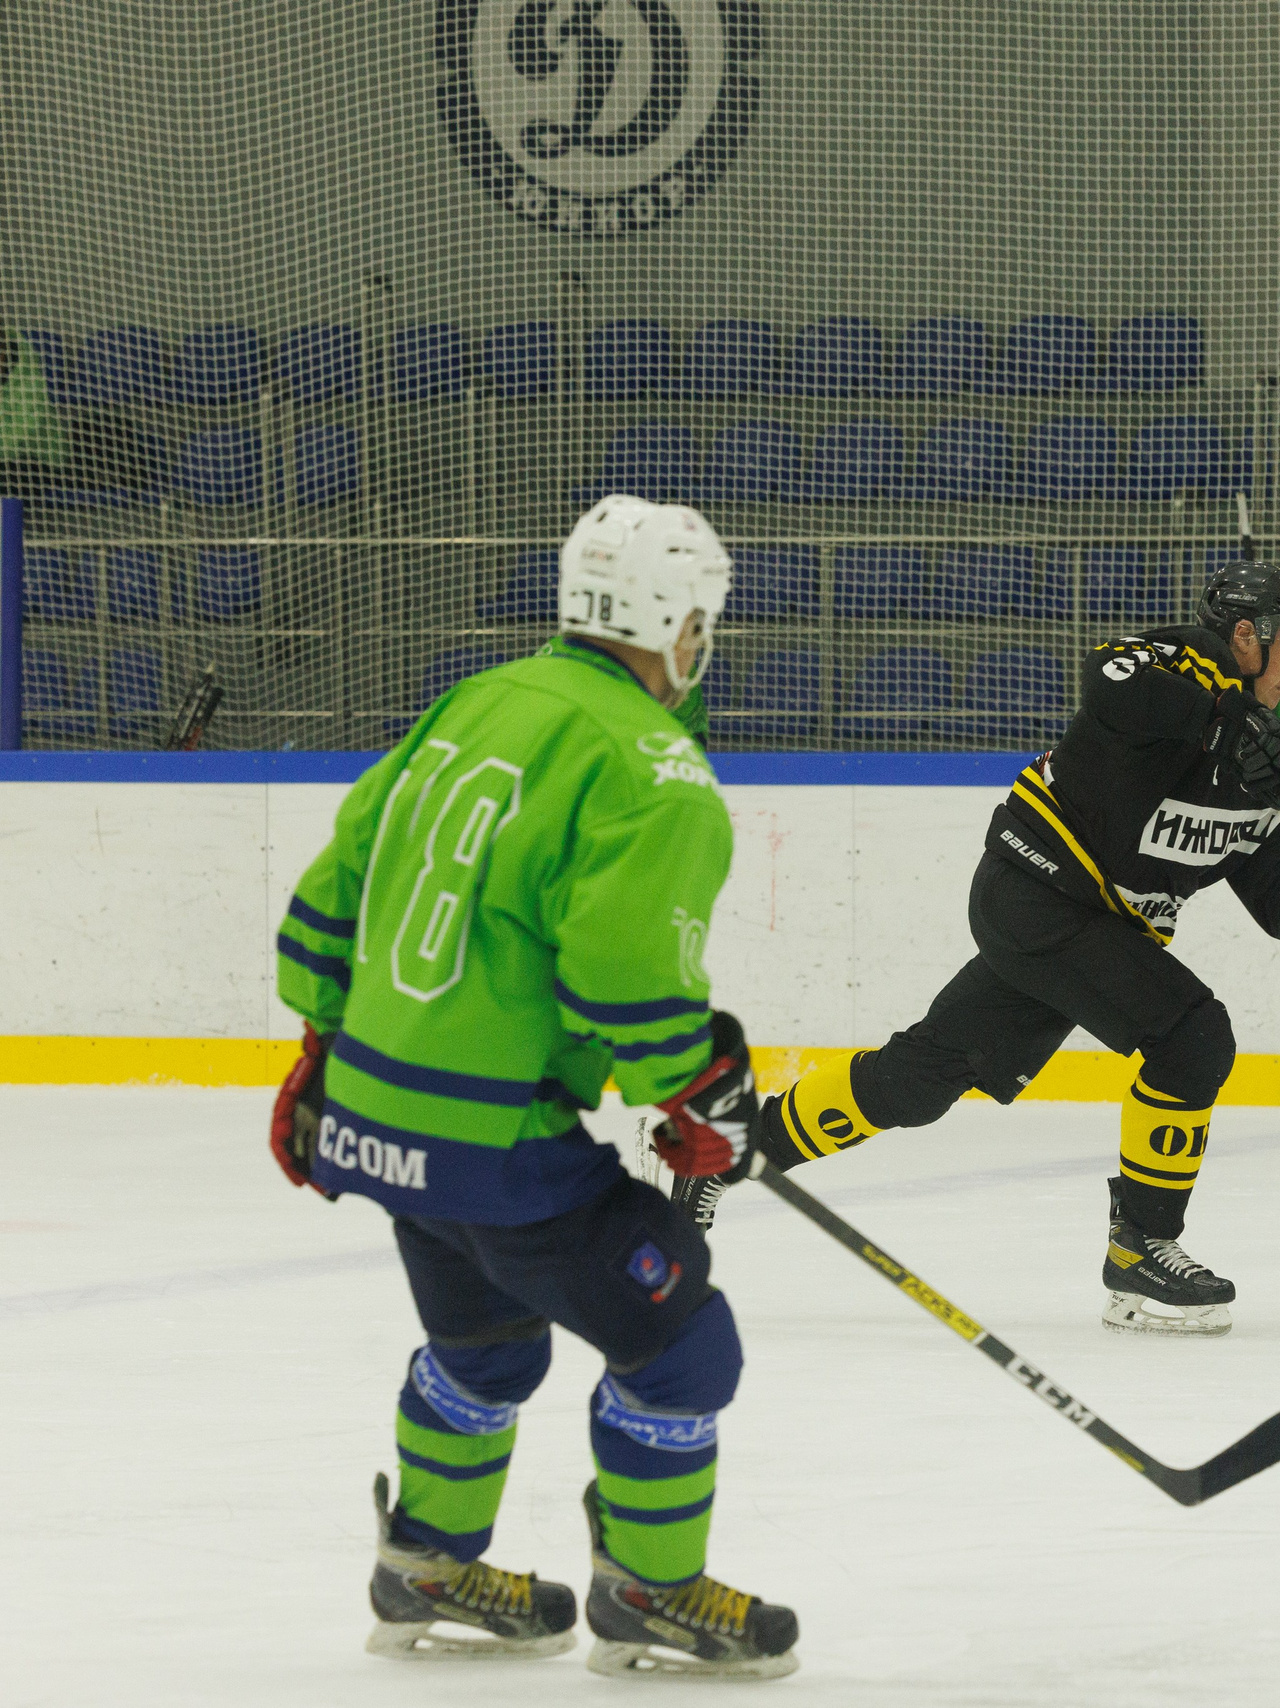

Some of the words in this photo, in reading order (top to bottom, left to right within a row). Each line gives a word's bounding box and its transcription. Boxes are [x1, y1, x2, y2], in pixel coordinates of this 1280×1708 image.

[582, 589, 612, 621] 78
[1209, 725, 1223, 751] BAUER
[1000, 829, 1060, 876] BAUER
[1138, 1266, 1167, 1286] BAUER
[1005, 1354, 1098, 1430] CCM
